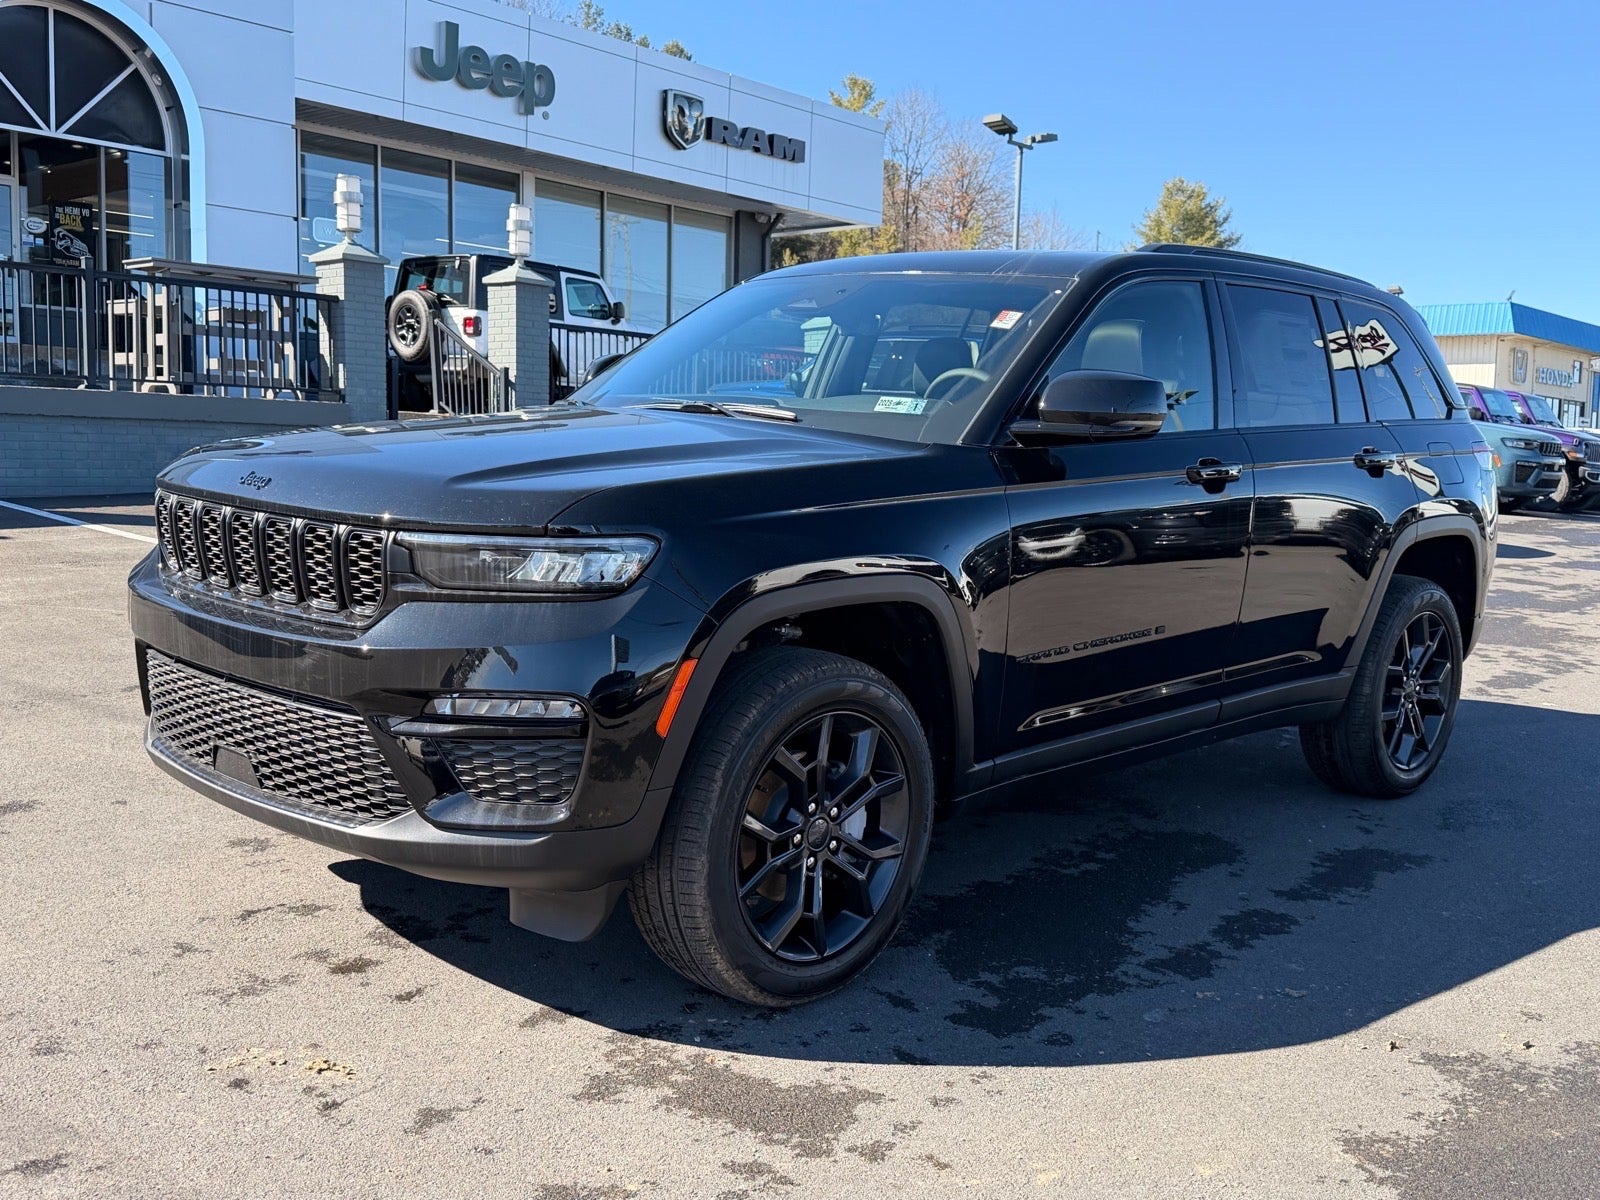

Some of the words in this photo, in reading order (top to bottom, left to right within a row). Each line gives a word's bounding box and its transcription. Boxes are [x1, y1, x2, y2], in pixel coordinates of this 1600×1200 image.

[411, 20, 556, 116] Jeep
[705, 116, 806, 163] RAM
[59, 213, 82, 227] BACK
[64, 205, 81, 215] HEMI
[81, 208, 90, 217] V8
[1537, 367, 1576, 388] HONDA
[239, 470, 272, 490] Jeep
